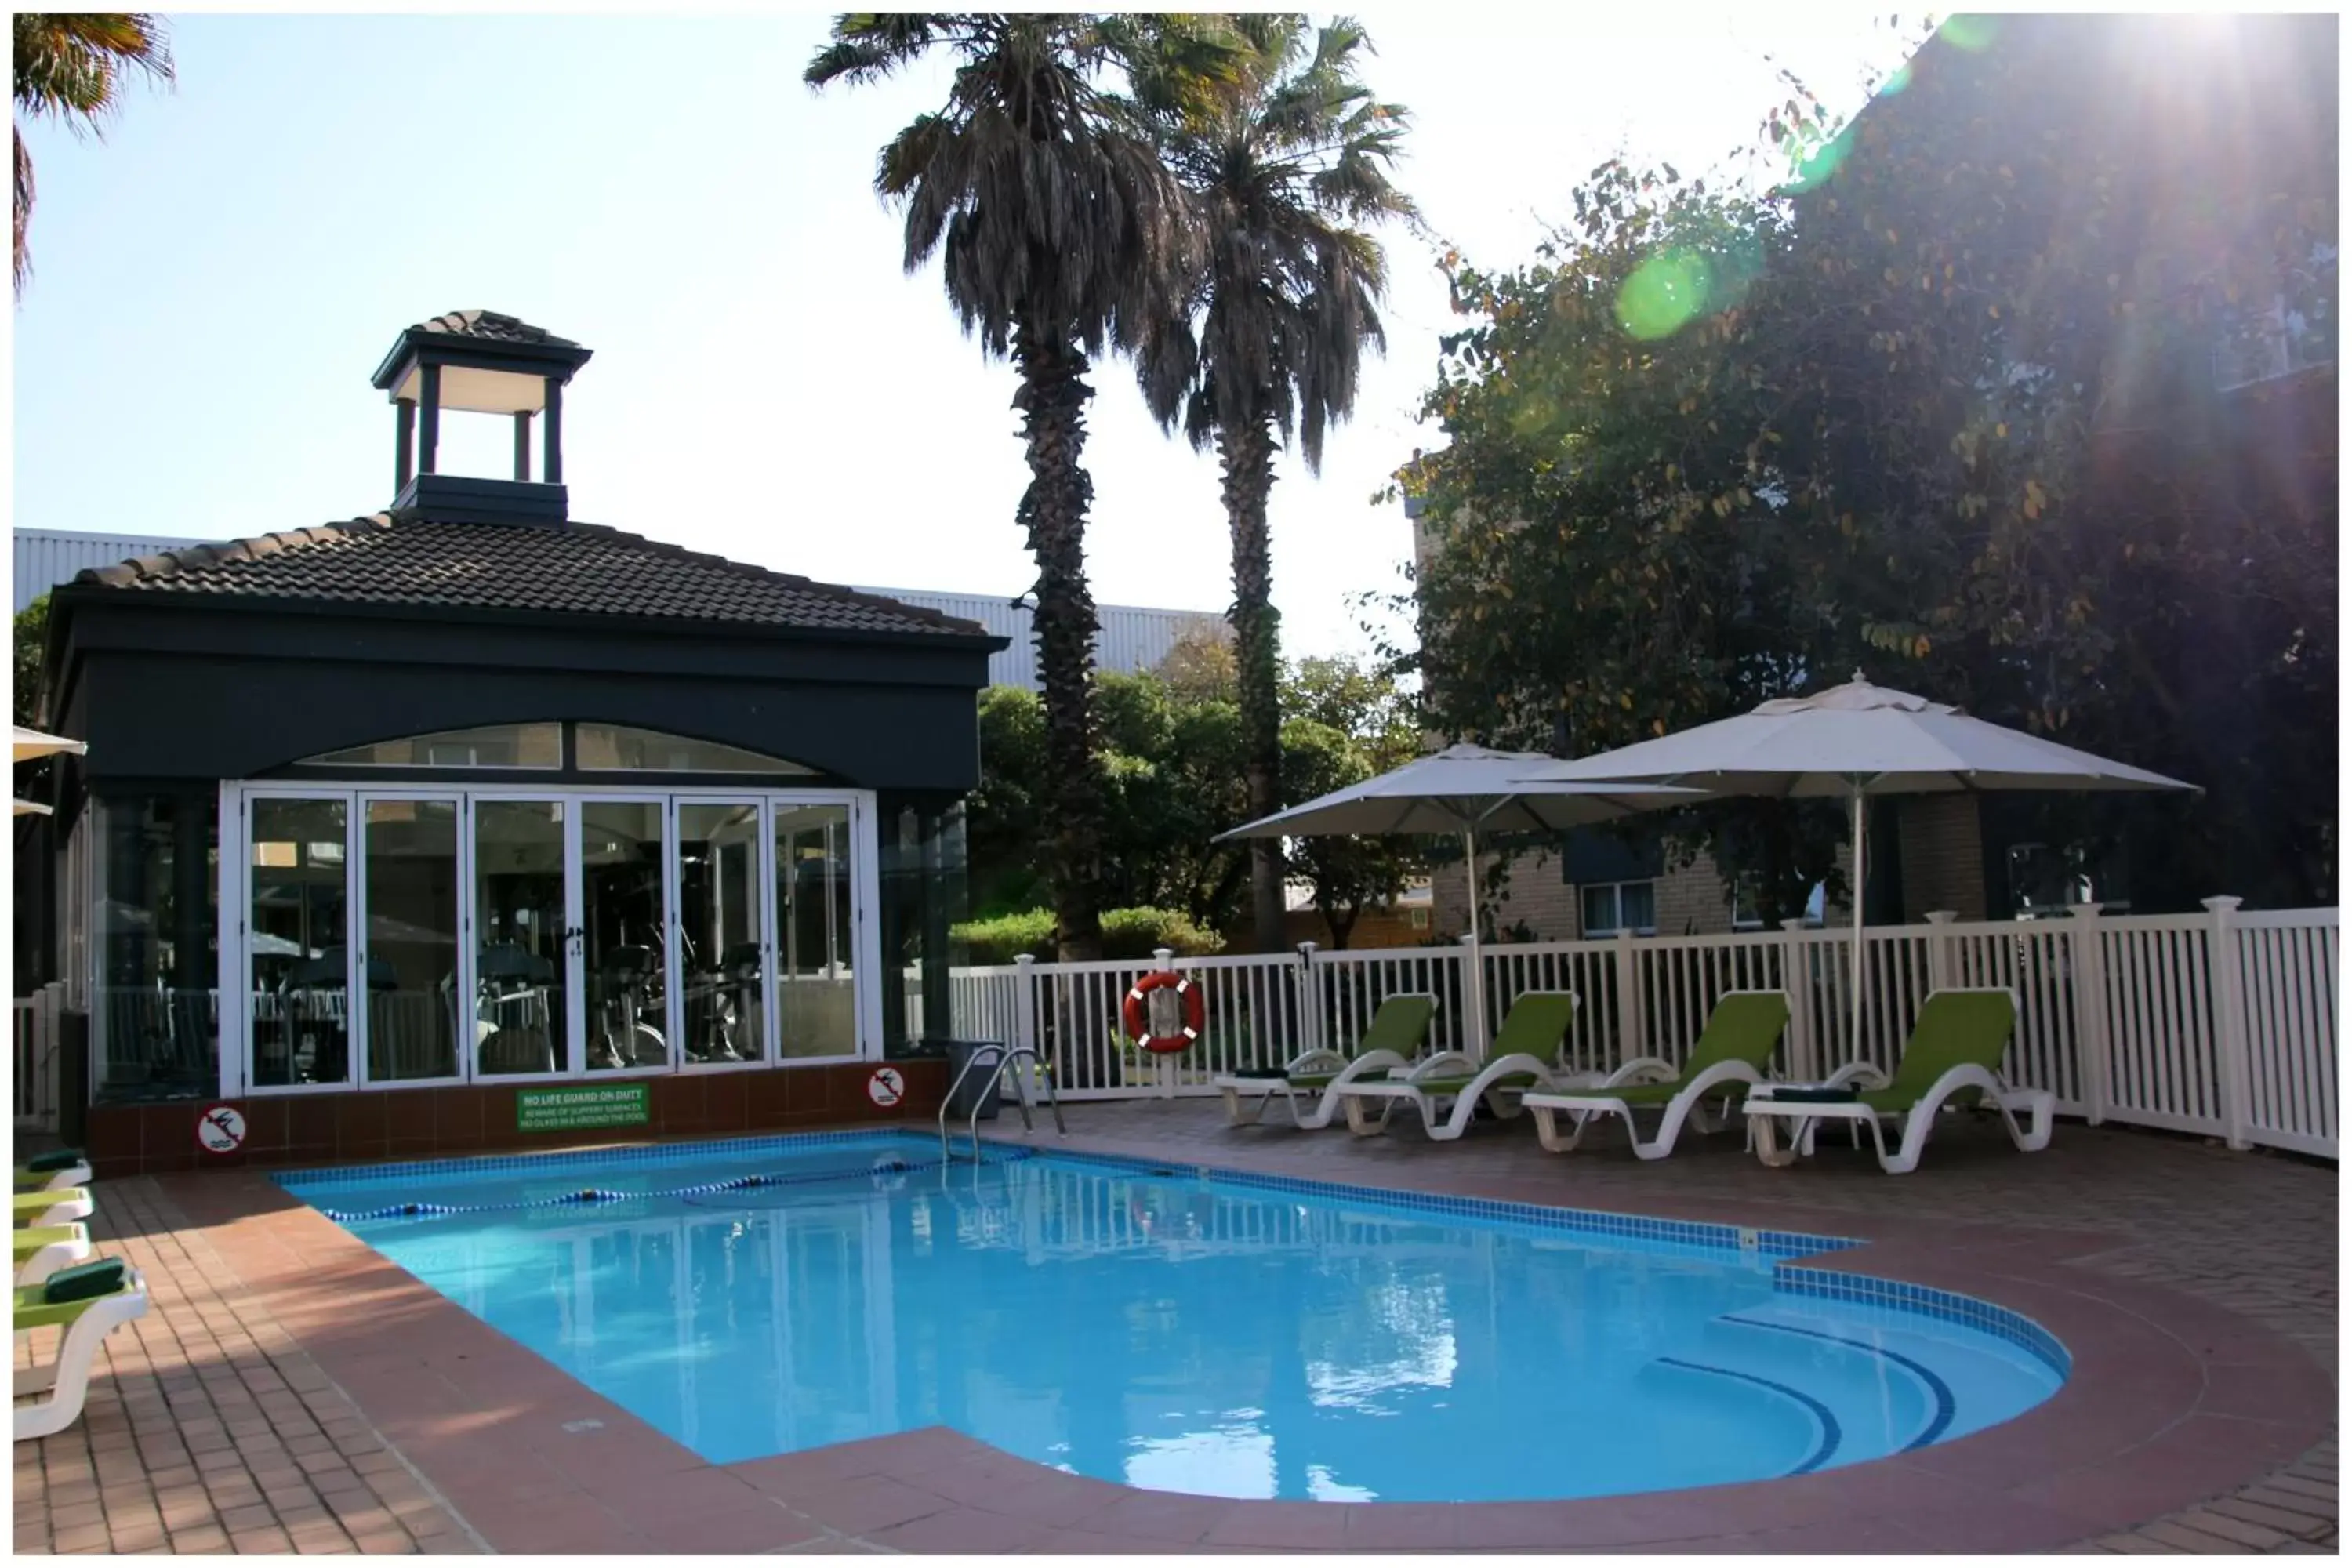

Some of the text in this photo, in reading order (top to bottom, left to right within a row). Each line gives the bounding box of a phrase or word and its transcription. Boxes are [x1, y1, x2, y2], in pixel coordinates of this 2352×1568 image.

[524, 1089, 642, 1106] NO LIFE GUARD ON DUTY
